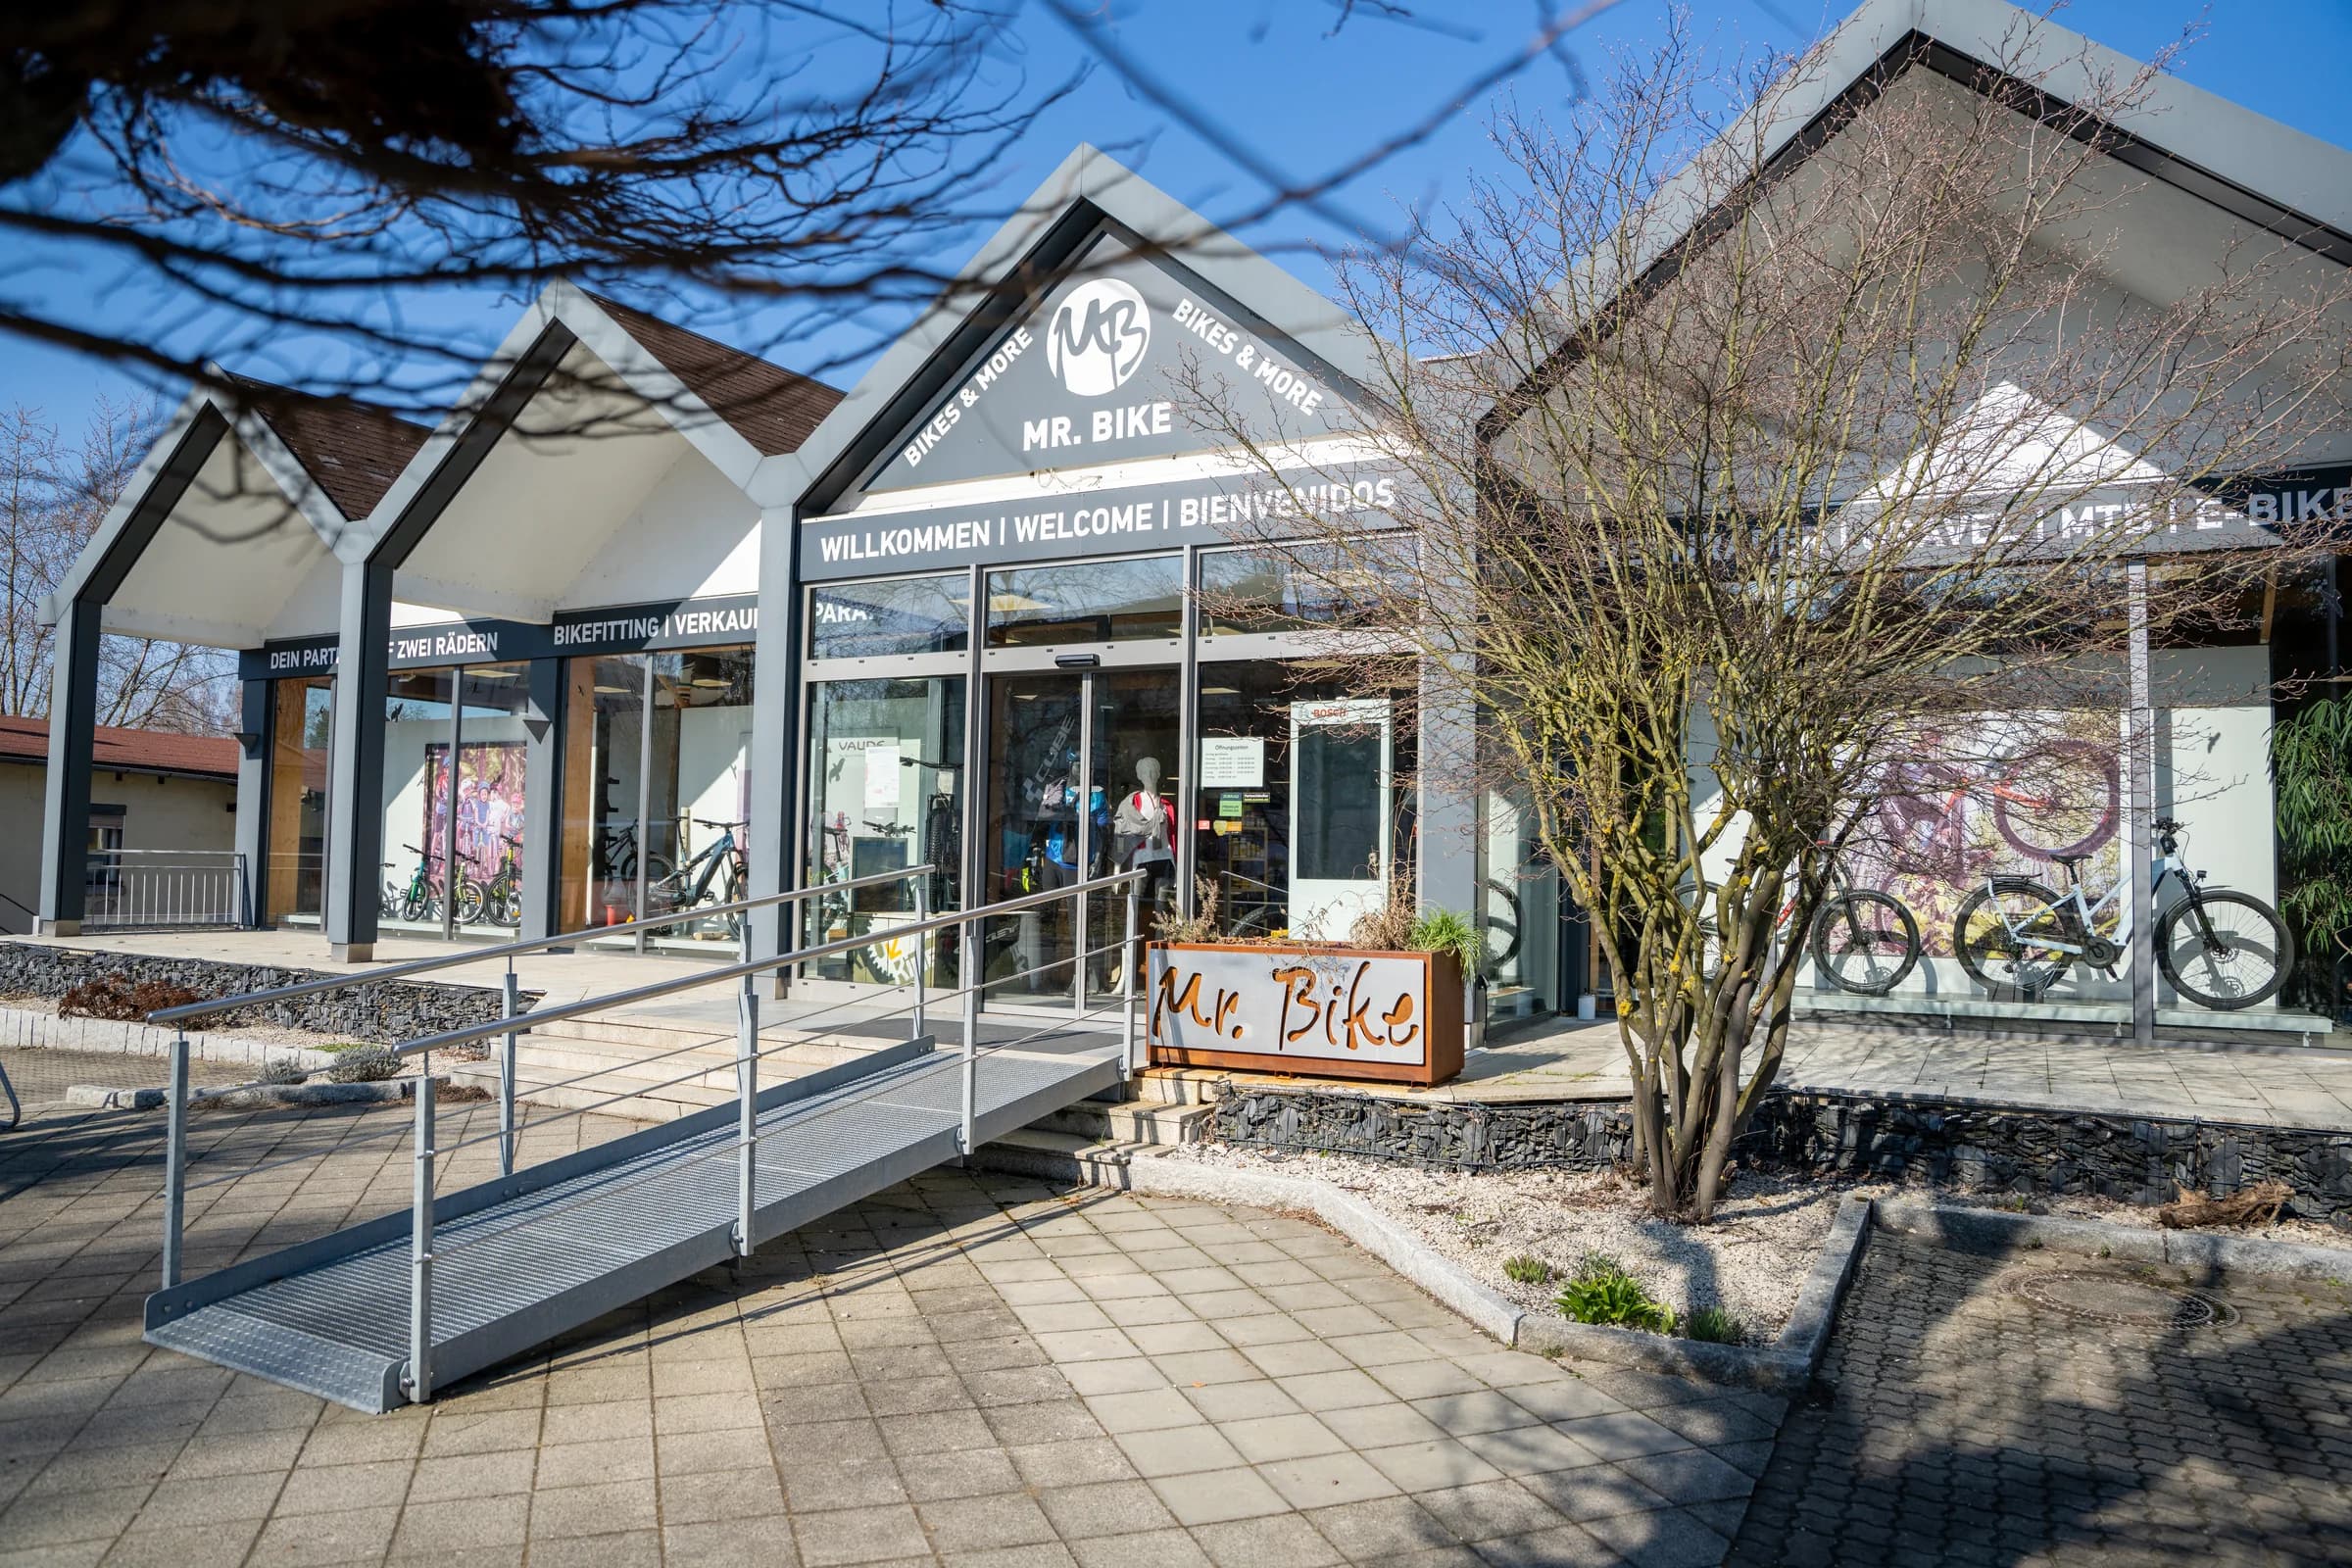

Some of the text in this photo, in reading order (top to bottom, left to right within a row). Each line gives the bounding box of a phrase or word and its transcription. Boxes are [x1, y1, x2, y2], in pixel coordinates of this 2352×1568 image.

[1171, 298, 1323, 416] BIKES & MORE
[904, 325, 1034, 467] BIKES & MORE
[1022, 401, 1173, 452] MR. BIKE
[820, 519, 990, 563] WILLKOMMEN
[1013, 502, 1153, 543] WELCOME
[1180, 478, 1396, 527] BIENVENIDOS
[2061, 502, 2153, 539] MTB
[270, 648, 300, 669] DEIN
[397, 637, 431, 659] ZWEI
[436, 631, 499, 656] RÄDERN
[553, 617, 660, 646] BIKEFITTING
[1152, 960, 1420, 1052] Mr. Bike
